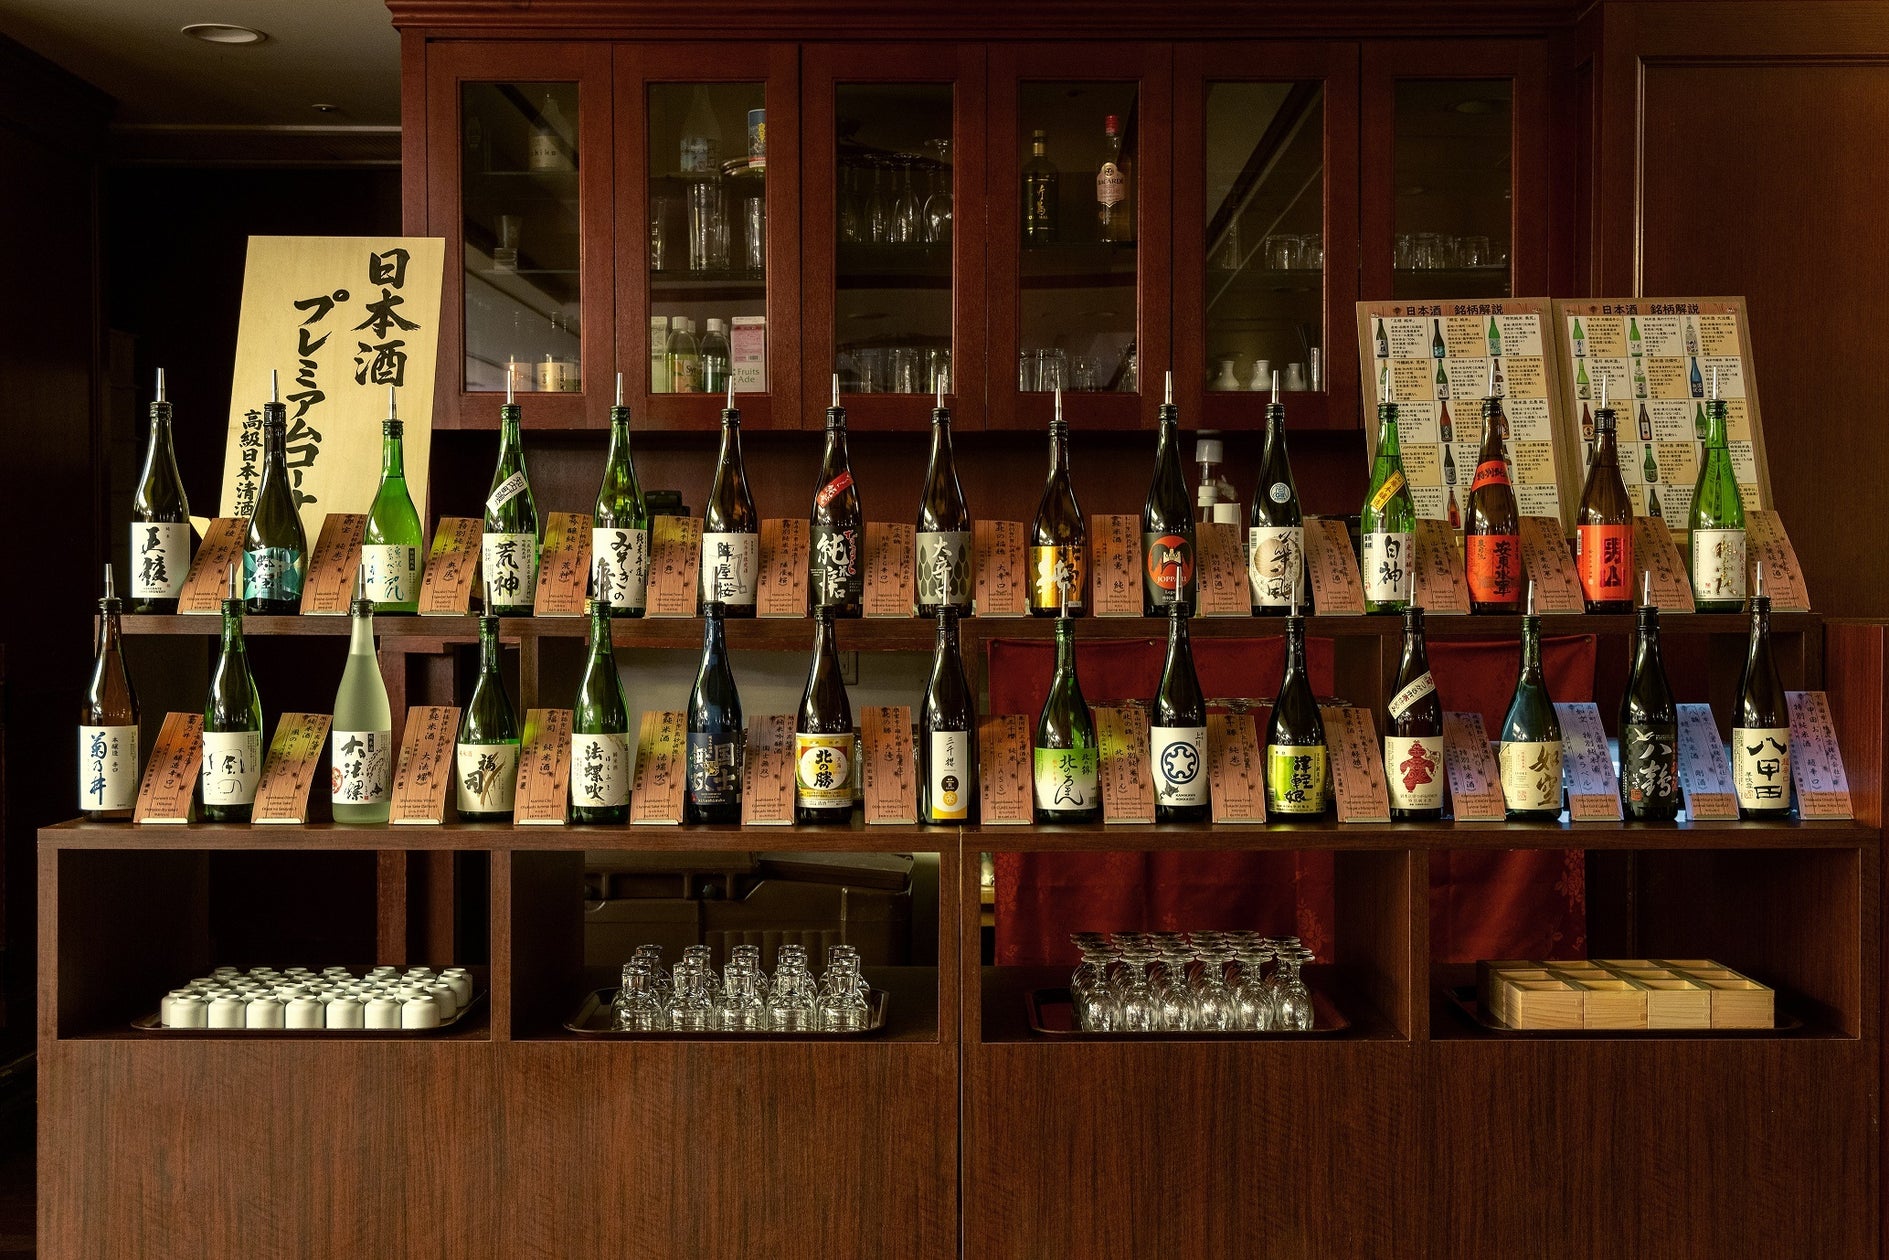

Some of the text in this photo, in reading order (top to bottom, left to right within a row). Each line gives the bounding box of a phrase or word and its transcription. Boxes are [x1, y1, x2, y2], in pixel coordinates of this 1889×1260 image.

[351, 248, 421, 387] 日本酒
[1406, 304, 1503, 316] 日本酒 銘柄解説
[1602, 303, 1700, 315] 日本酒 銘柄解説
[737, 368, 760, 376] Fruits
[234, 409, 264, 517] 高級日本清酒
[494, 541, 519, 598] 荒神
[717, 542, 737, 599] 陣屋桜
[1376, 535, 1404, 593] 白神
[1493, 540, 1512, 597] 安東水軍
[89, 731, 107, 805] 菊乃井
[111, 761, 119, 773] 辛口
[340, 735, 366, 801] 大法螺
[464, 752, 496, 795] 福司
[585, 741, 605, 802] 法螺吹
[813, 749, 834, 789] 北の勝
[1081, 753, 1091, 776] 北の錦
[1638, 743, 1673, 797] 八鶴
[1746, 736, 1787, 799] 八甲田
